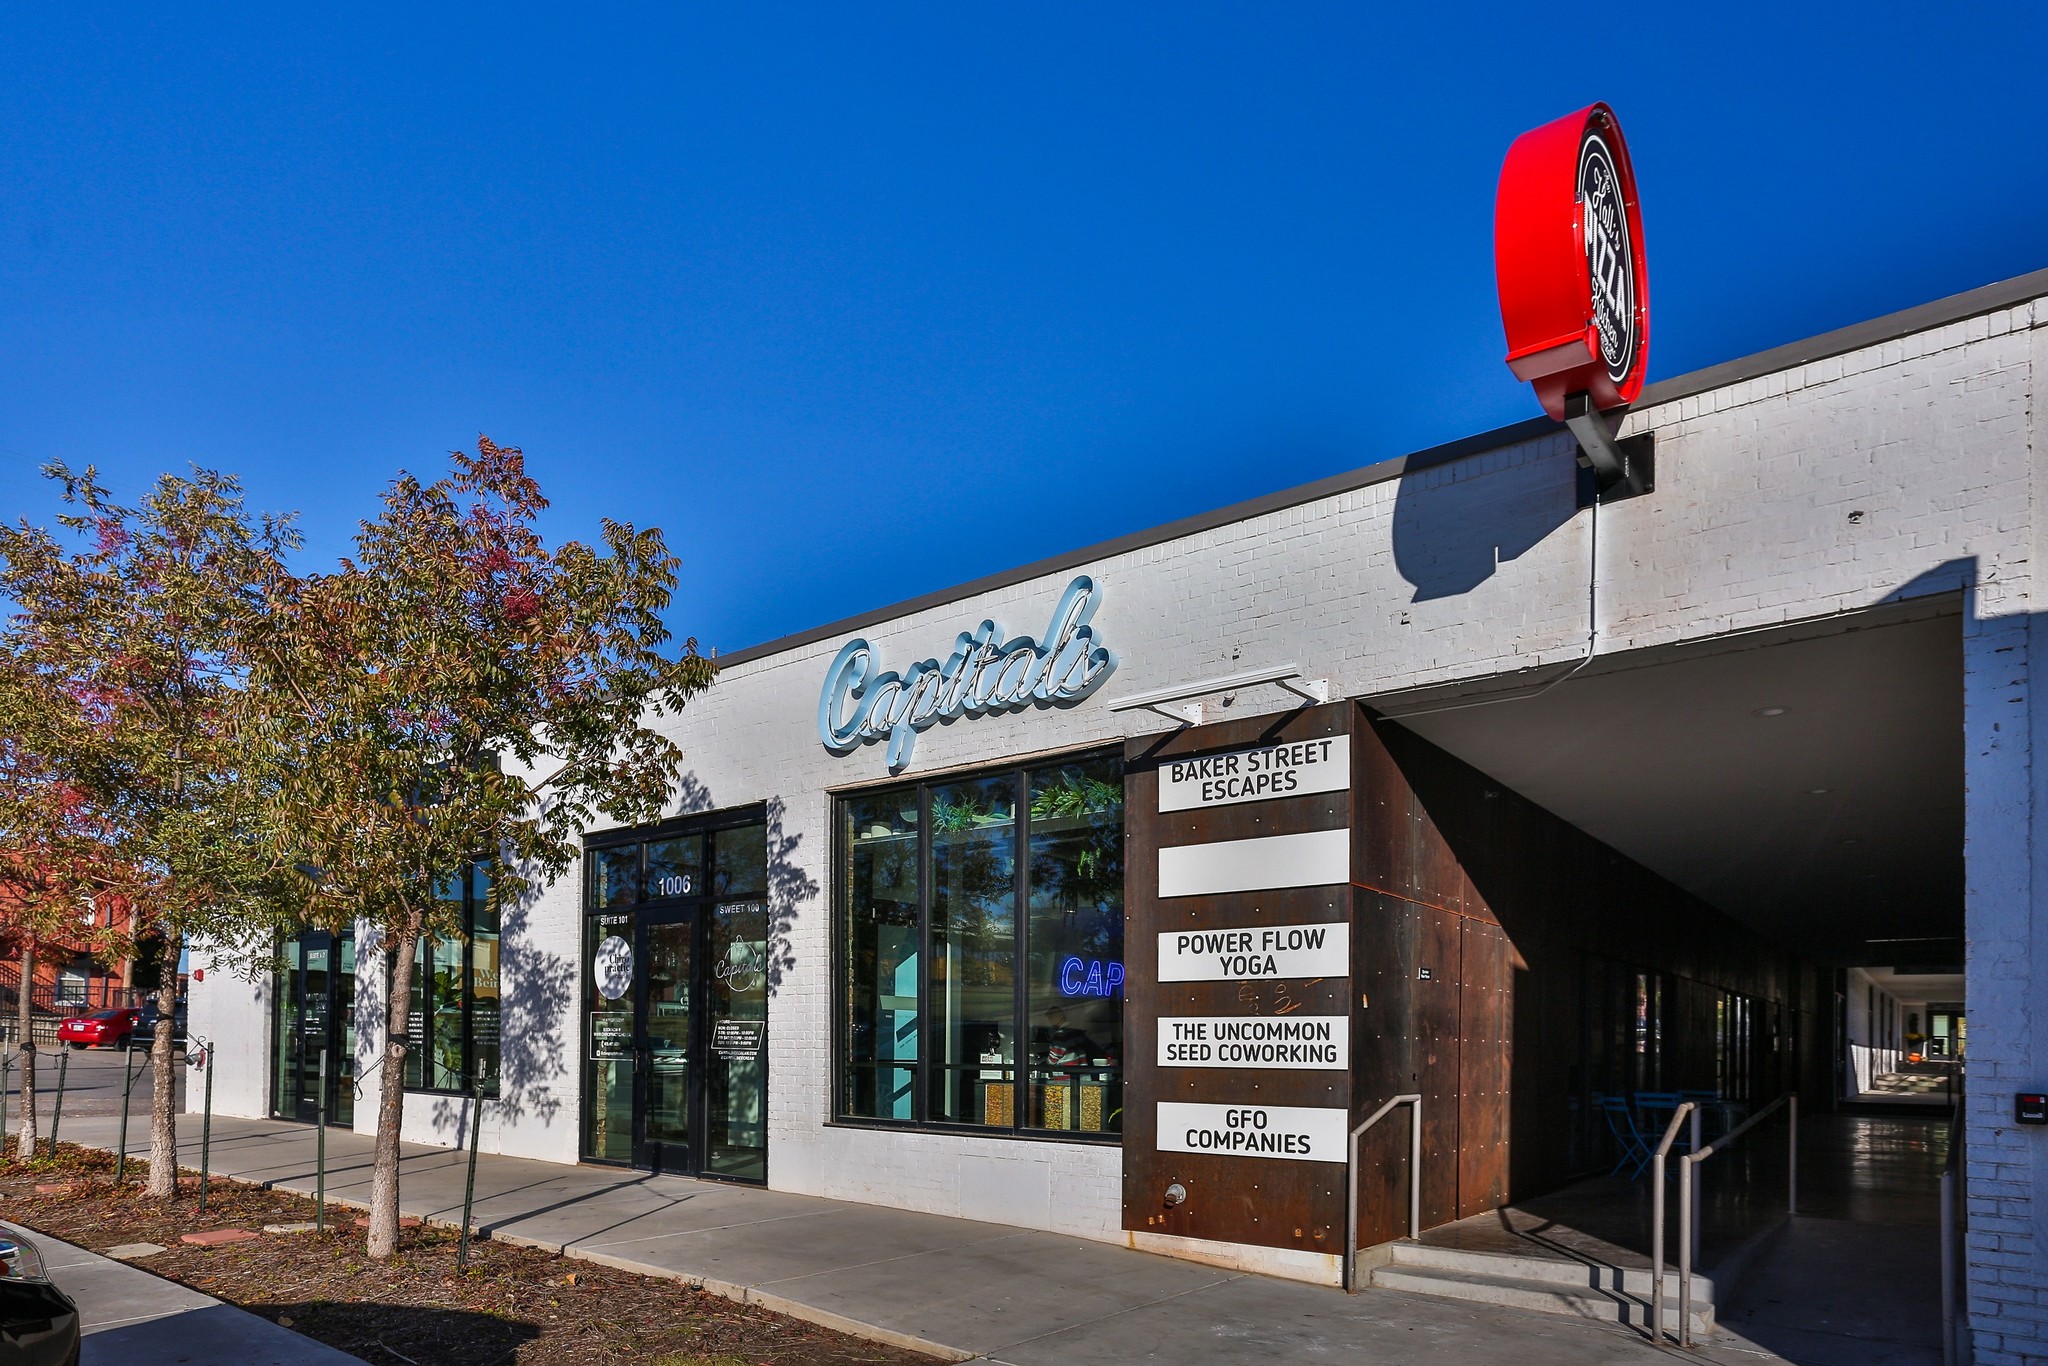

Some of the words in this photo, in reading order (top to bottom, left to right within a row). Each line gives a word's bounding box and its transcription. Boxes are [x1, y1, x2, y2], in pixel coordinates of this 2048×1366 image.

[1592, 167, 1621, 252] Hall's
[1583, 190, 1627, 332] PIZZA
[1591, 277, 1619, 348] Kitchen
[818, 575, 1118, 772] Capitals
[1171, 754, 1239, 784] BAKER
[1249, 740, 1333, 770] STREET
[1202, 769, 1298, 802] ESCAPES
[659, 875, 691, 896] 1006
[600, 916, 617, 926] SUITE
[618, 915, 628, 924] 101
[719, 904, 745, 914] SWEET
[747, 903, 760, 912] 100
[1177, 932, 1253, 955] POWER
[1262, 928, 1326, 951] FLOW
[1061, 956, 1125, 997] CAP
[1219, 955, 1278, 976] YOGA
[1172, 1023, 1207, 1040] THE
[1214, 1023, 1331, 1041] UNCOMMON
[1167, 1043, 1211, 1061] SEED
[1218, 1043, 1338, 1063] COWORKING
[1226, 1109, 1268, 1129] GFO
[1186, 1129, 1311, 1154] COMPANIES
